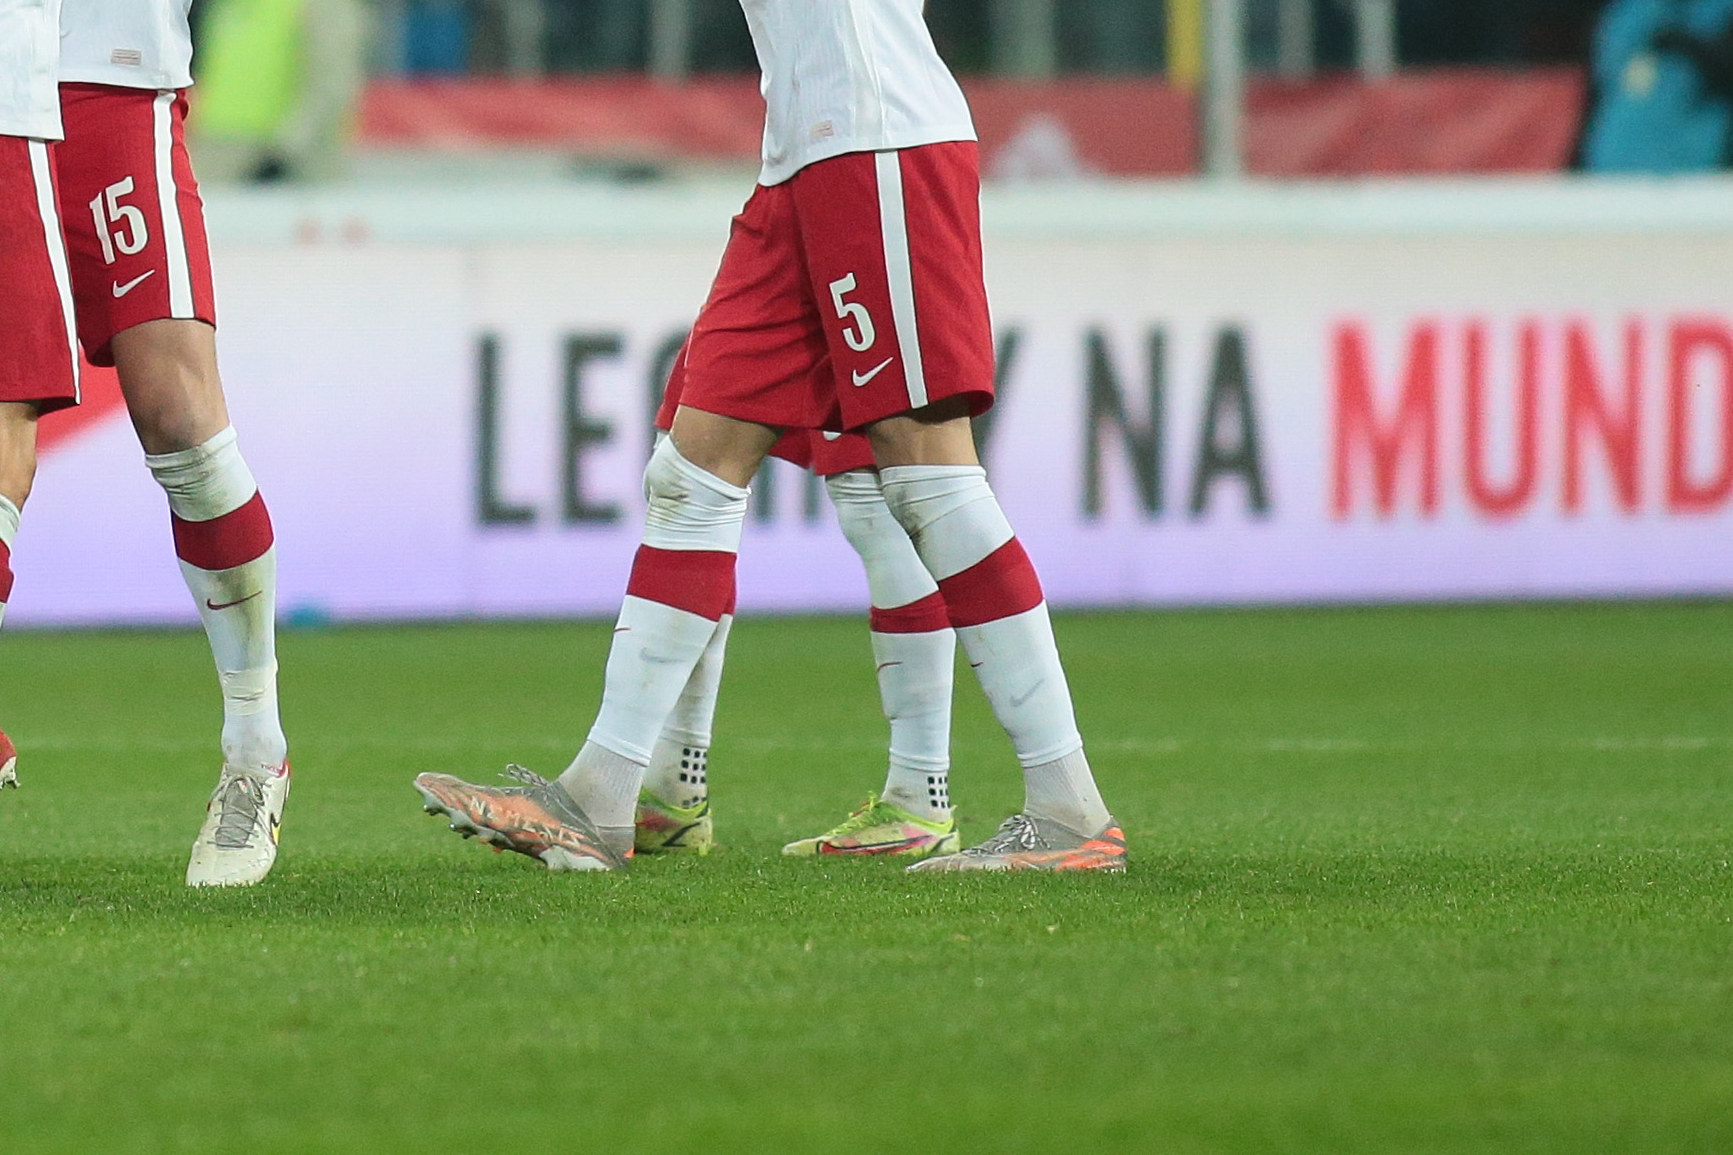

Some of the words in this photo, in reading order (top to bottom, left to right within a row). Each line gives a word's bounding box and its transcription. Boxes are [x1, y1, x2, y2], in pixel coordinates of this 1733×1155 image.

[89, 176, 148, 265] 15
[829, 272, 876, 352] 5
[1082, 325, 1270, 520] NA
[1329, 317, 1732, 520] MUND
